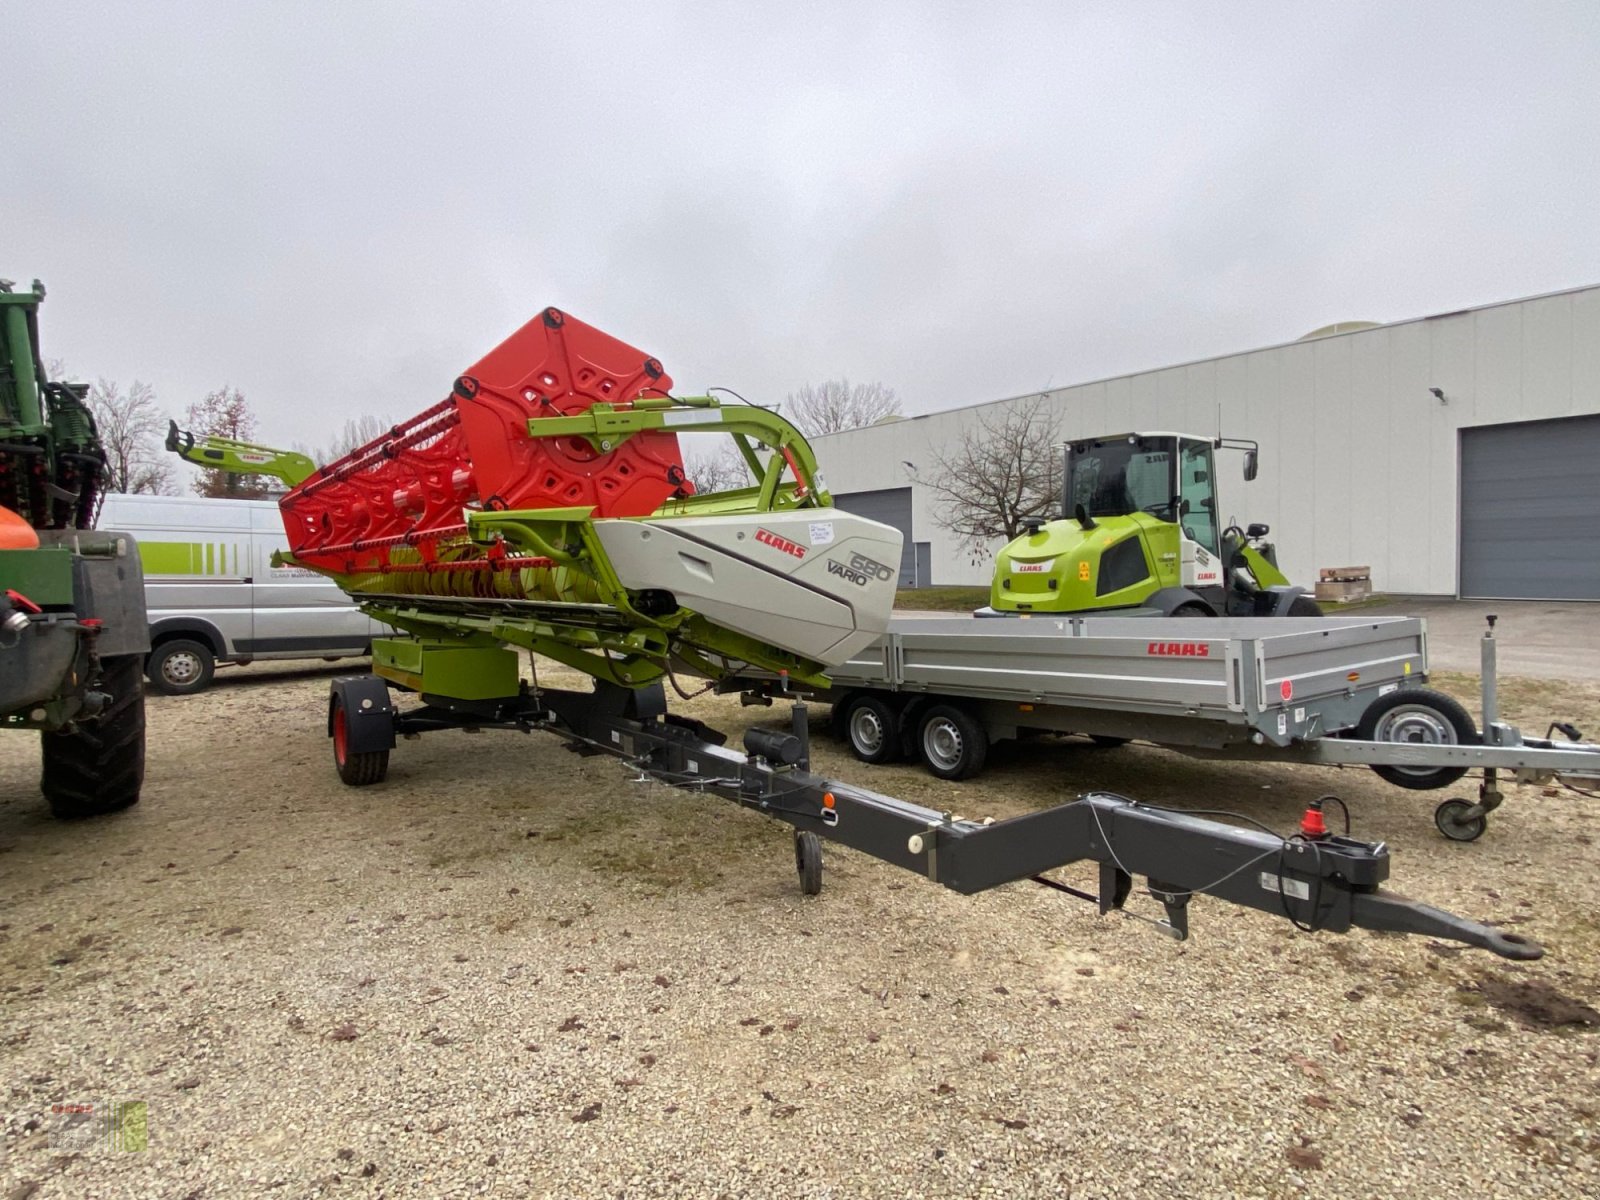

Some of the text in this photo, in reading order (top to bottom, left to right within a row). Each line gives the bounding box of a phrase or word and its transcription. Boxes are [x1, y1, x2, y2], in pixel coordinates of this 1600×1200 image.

[754, 529, 807, 559] CLAAS
[826, 560, 868, 587] VARIO
[850, 555, 892, 582] 680
[1197, 572, 1217, 580] CLAAS
[1148, 642, 1209, 657] CLAAS
